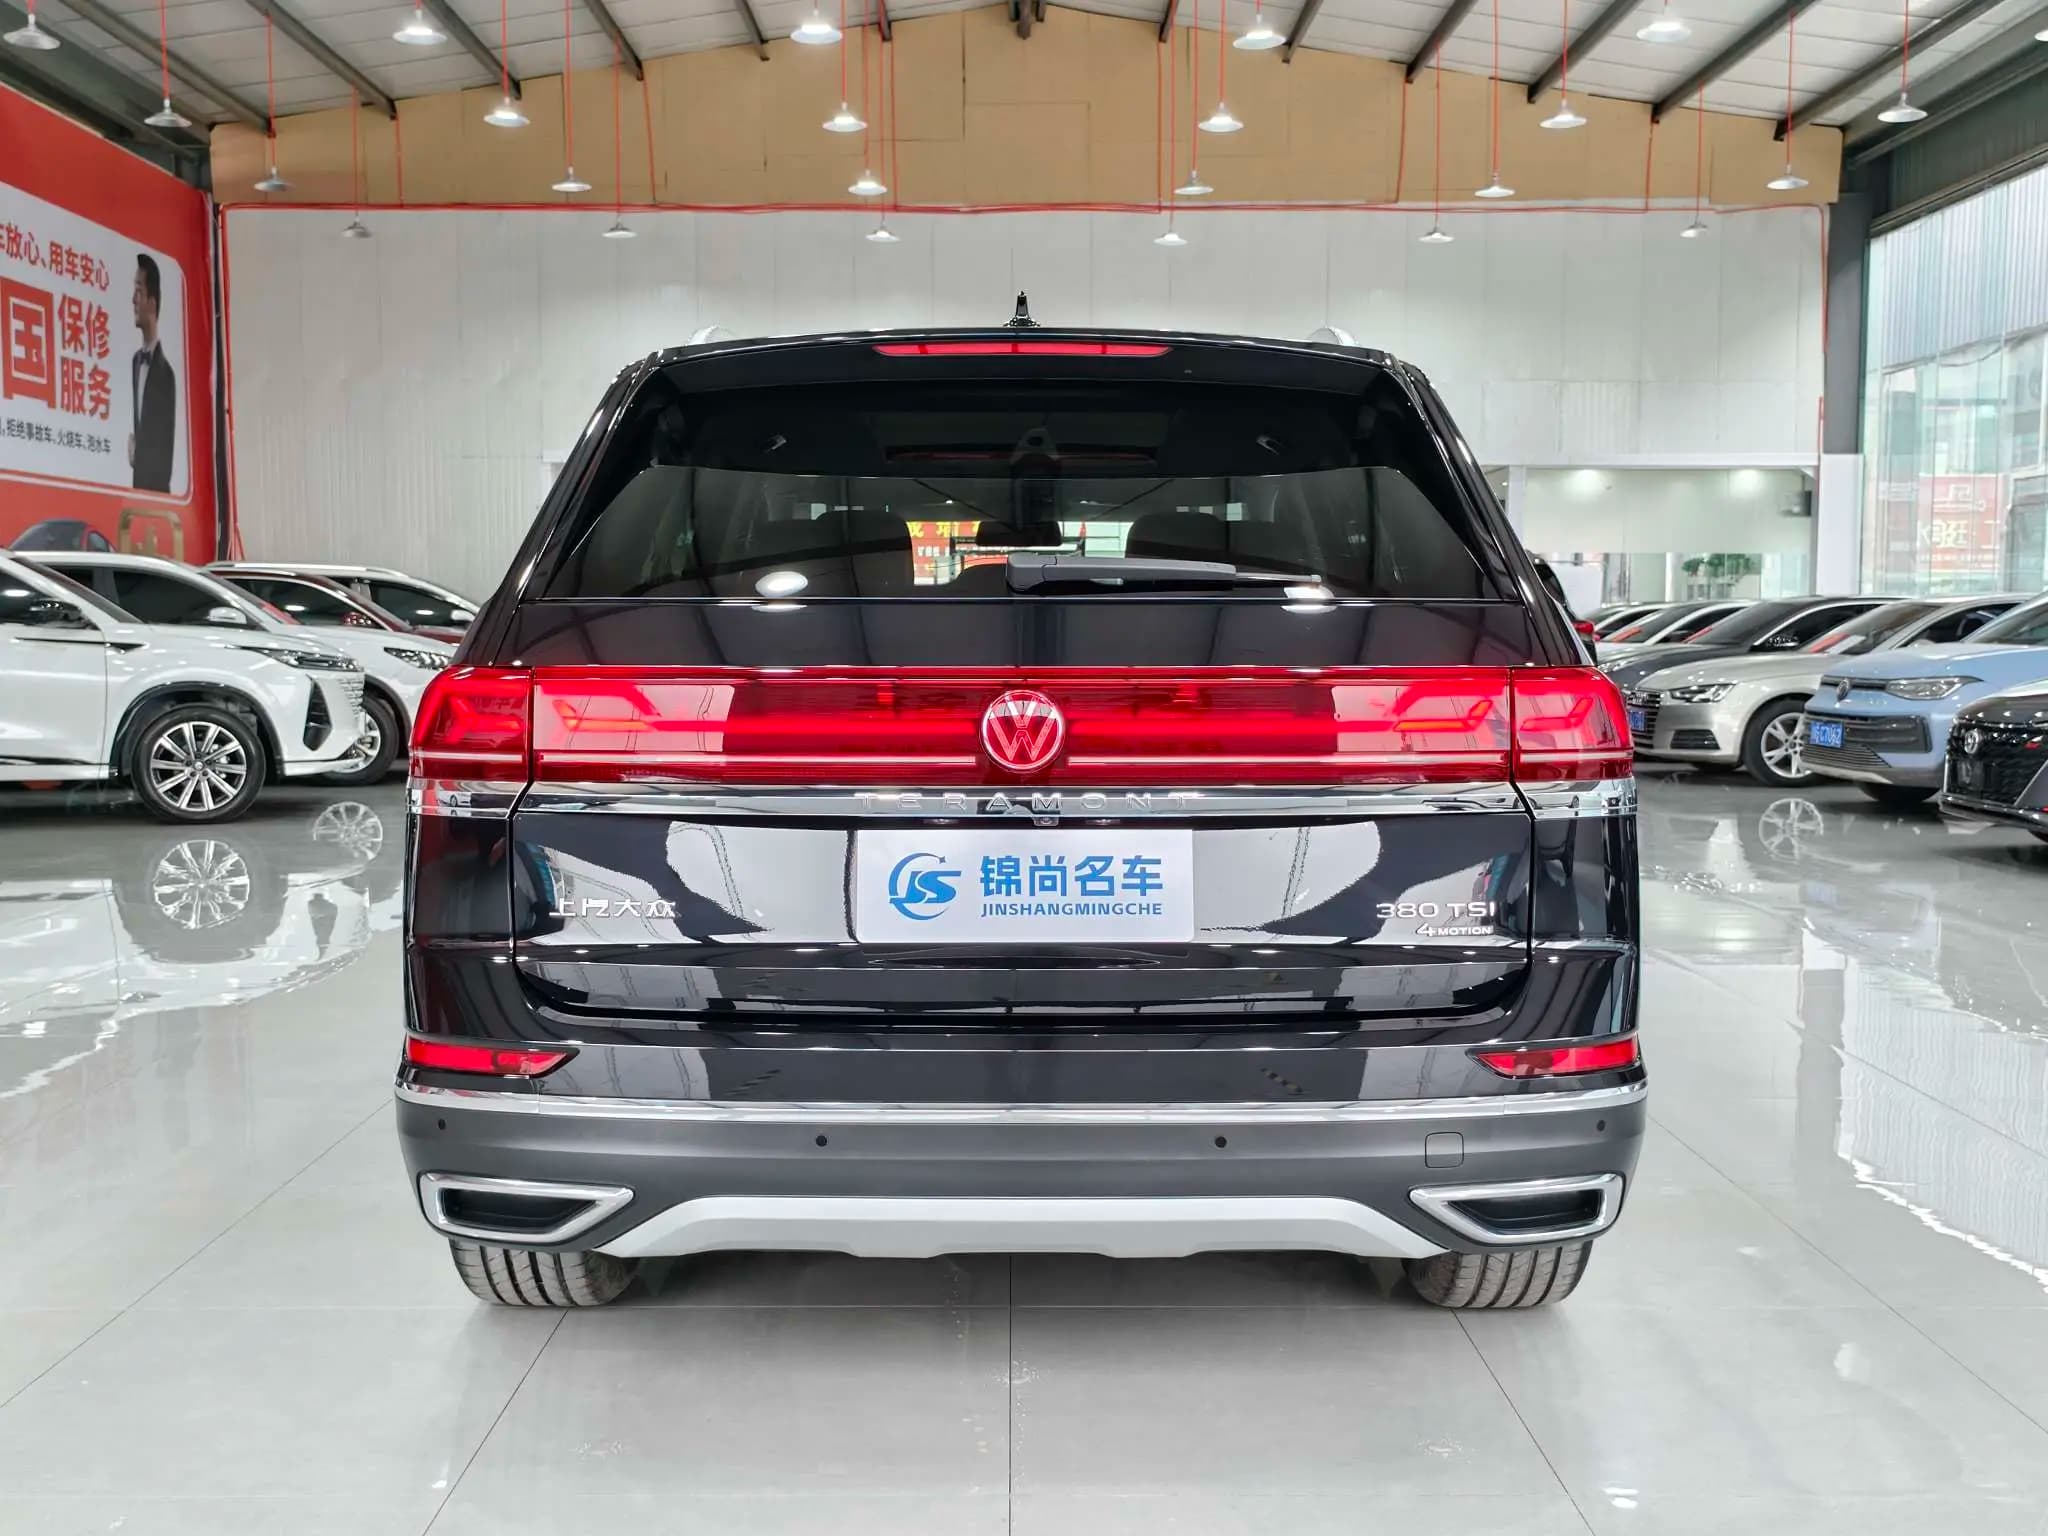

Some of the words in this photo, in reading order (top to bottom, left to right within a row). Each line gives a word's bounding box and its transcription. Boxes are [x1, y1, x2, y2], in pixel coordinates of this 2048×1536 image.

[0, 222, 110, 291] 放心、用车安心
[58, 293, 110, 360] 保修
[60, 356, 111, 421] 服务
[854, 791, 1196, 811] TERAMONT
[979, 854, 1164, 897] 锦尚名车
[548, 897, 678, 918] 上汽大众
[980, 902, 1163, 918] JINSHANGMINGCHE
[1375, 902, 1440, 919] 380
[1445, 901, 1496, 918] TSI
[1416, 922, 1494, 938] 4MOTION
